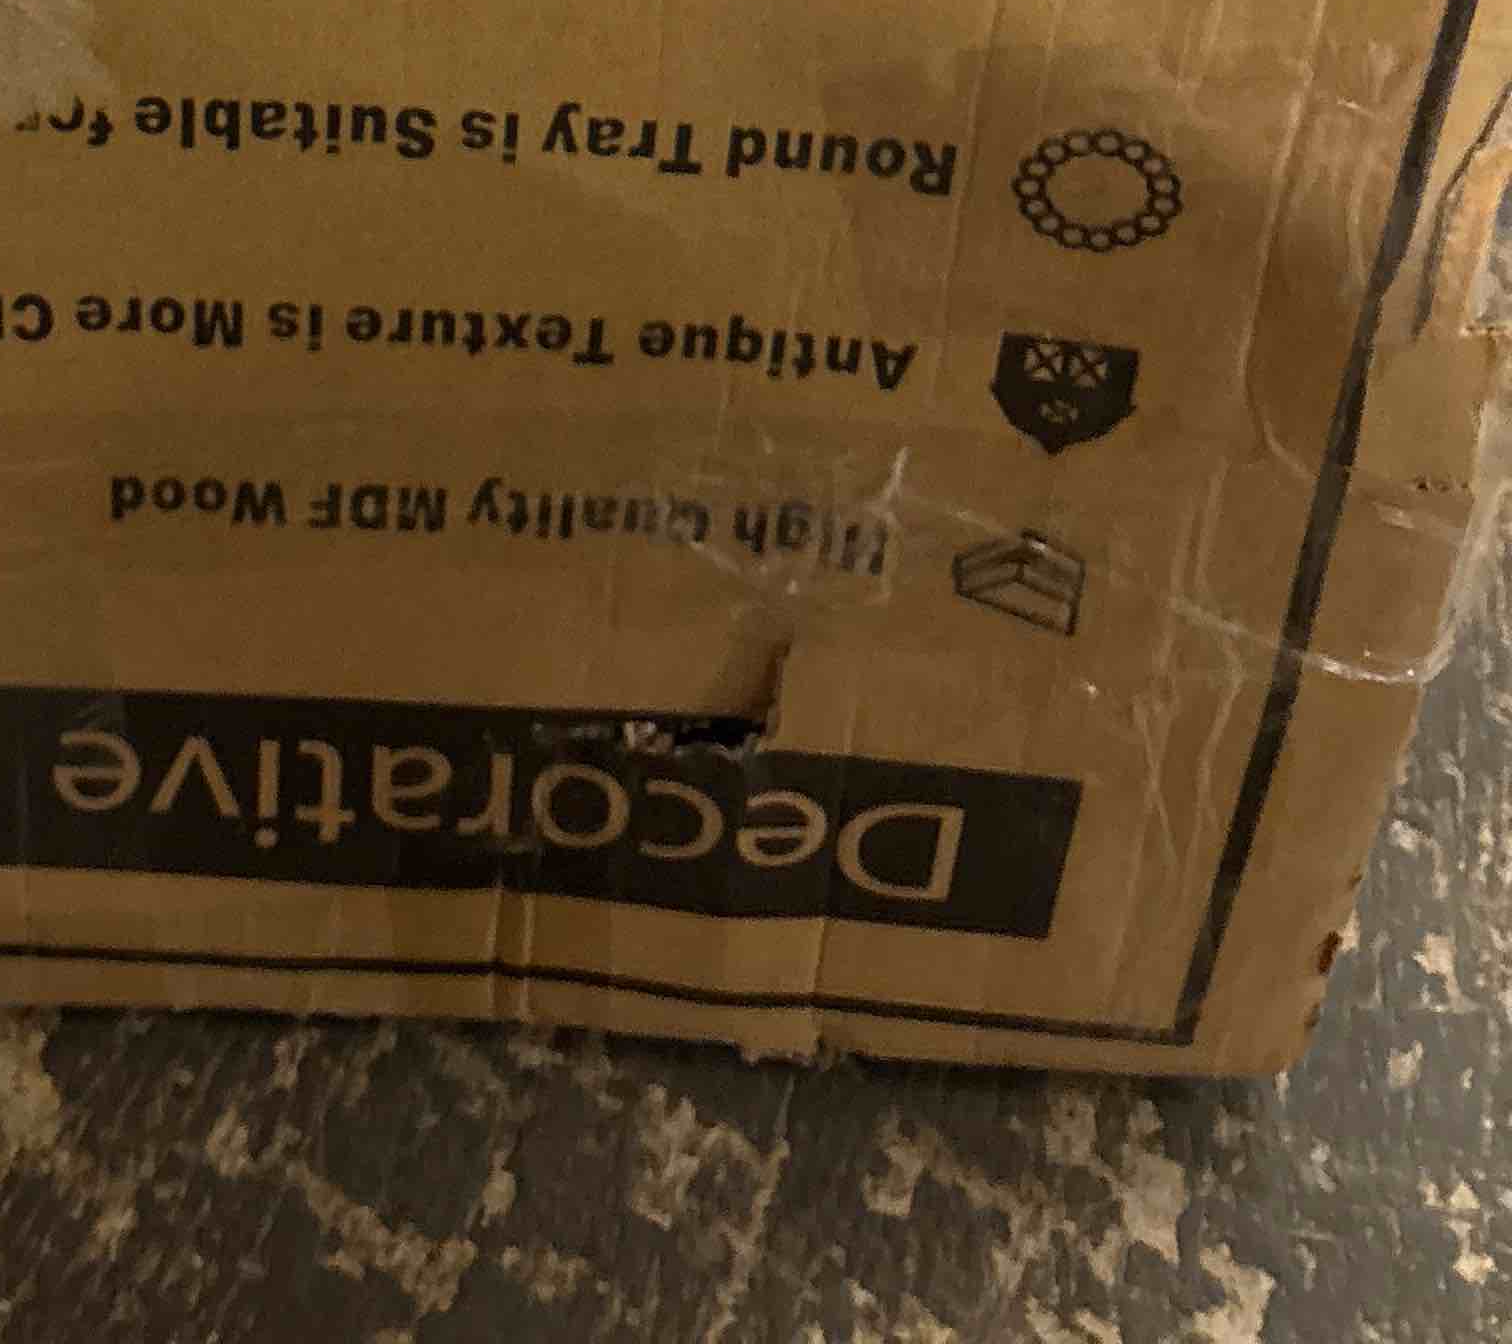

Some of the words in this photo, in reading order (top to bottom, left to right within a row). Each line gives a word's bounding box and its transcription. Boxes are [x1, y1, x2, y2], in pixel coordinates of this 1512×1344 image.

[135, 94, 438, 161] Suitable
[461, 108, 519, 165] is
[541, 102, 703, 177] Tray
[725, 123, 959, 198] Round
[74, 294, 244, 350] More
[268, 299, 323, 356] is
[345, 304, 616, 368] Texture
[637, 313, 920, 392] Antique
[110, 474, 288, 529] Wood
[308, 481, 449, 534] MDF
[52, 725, 966, 904] Decorative
